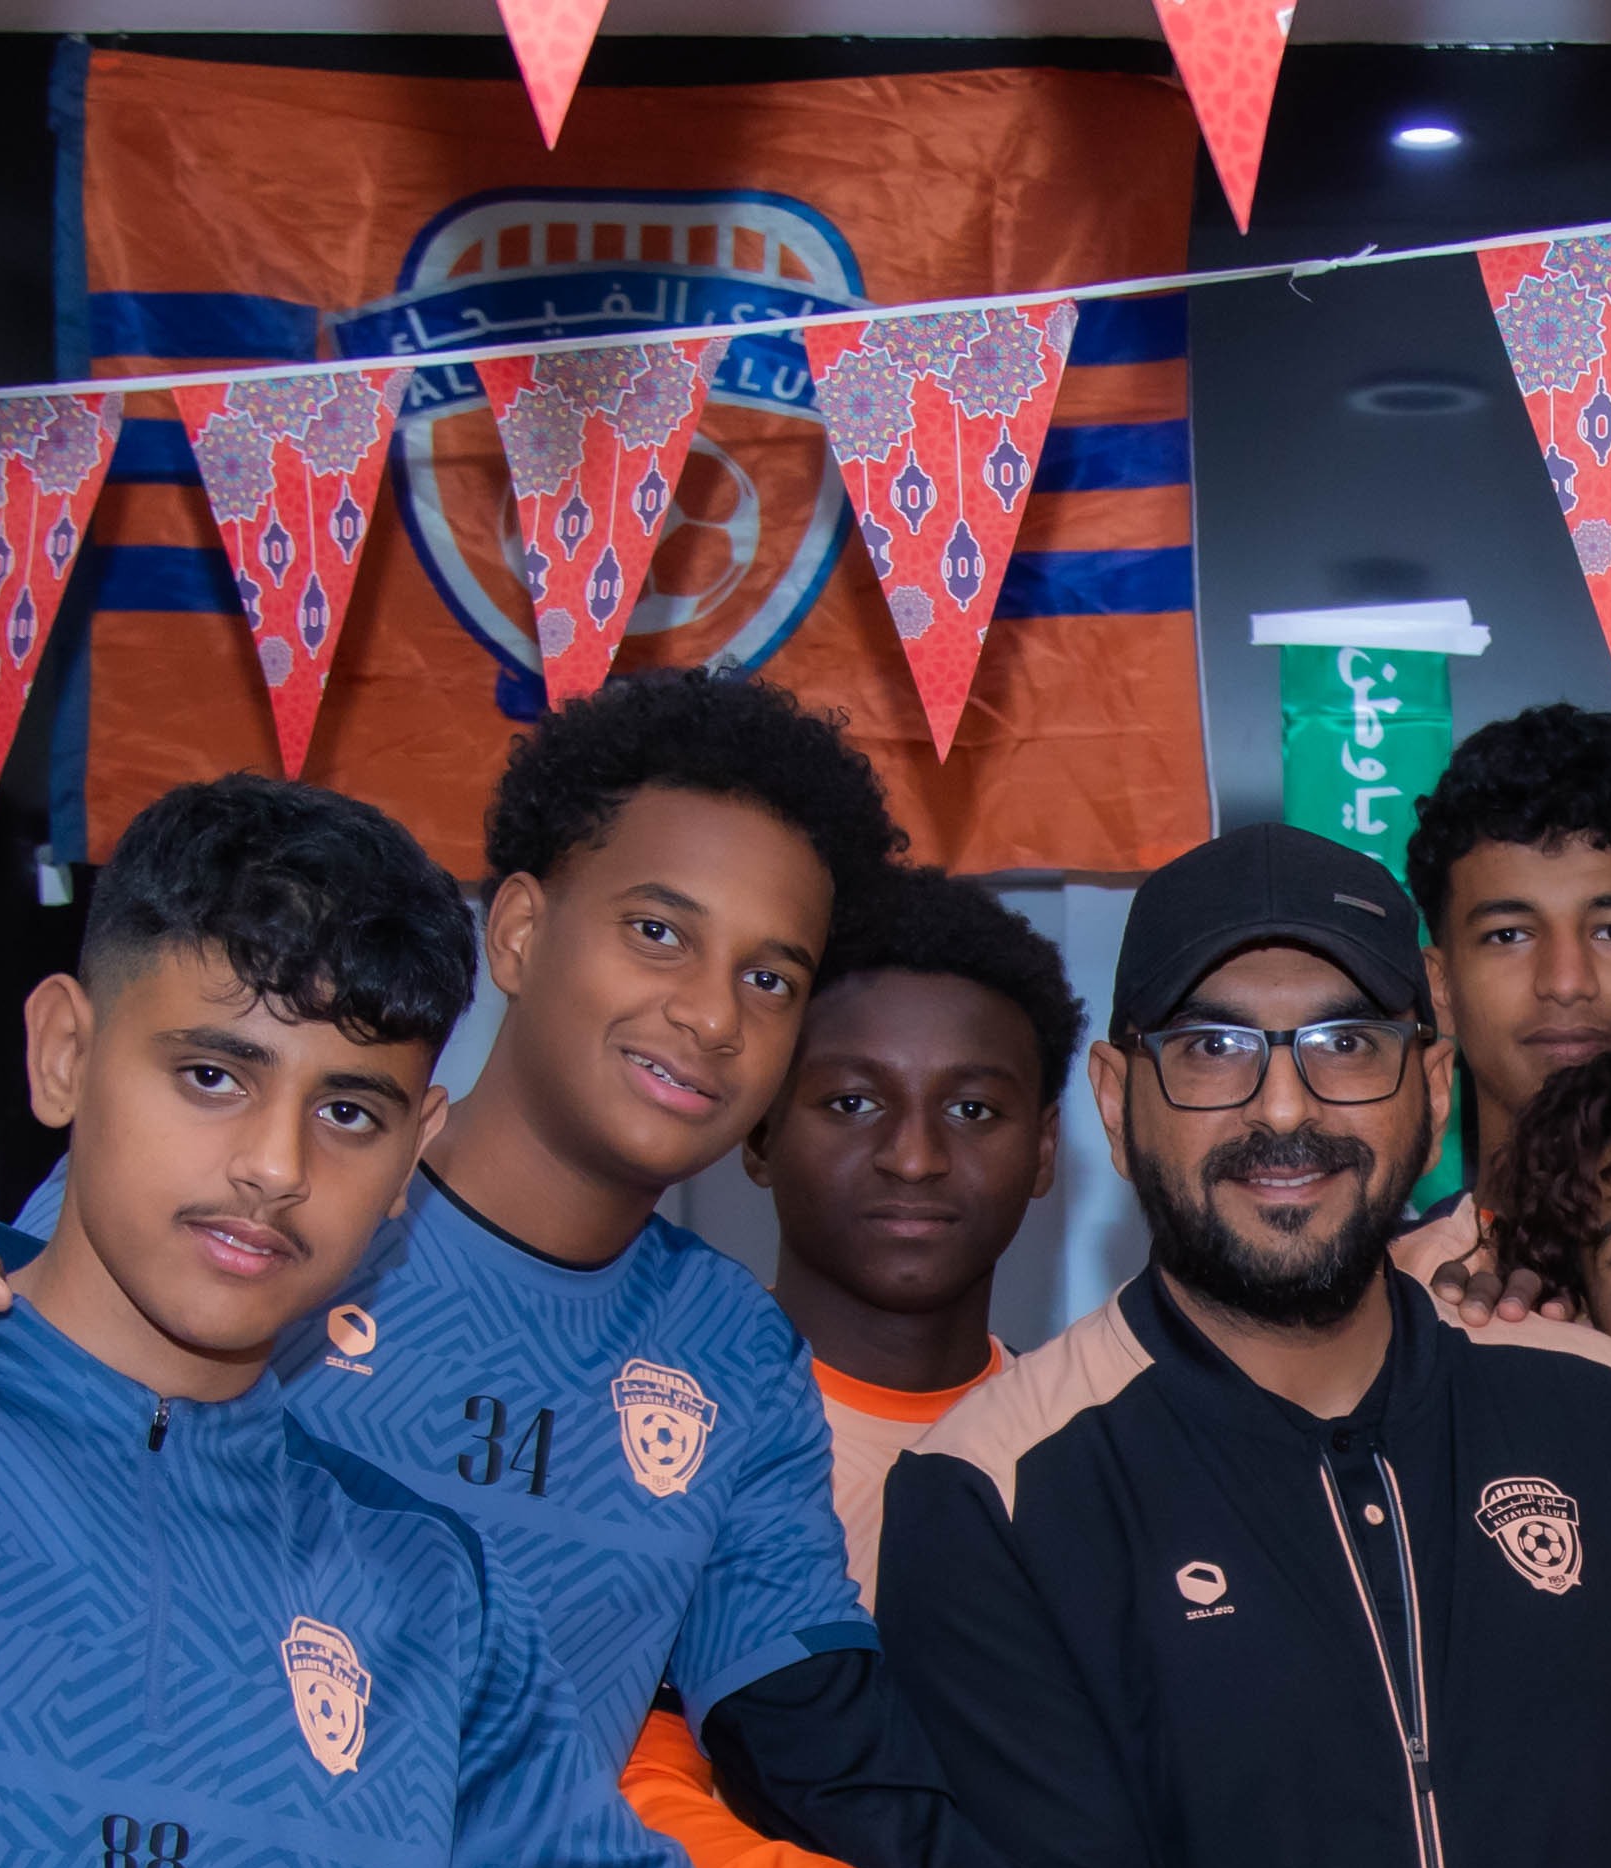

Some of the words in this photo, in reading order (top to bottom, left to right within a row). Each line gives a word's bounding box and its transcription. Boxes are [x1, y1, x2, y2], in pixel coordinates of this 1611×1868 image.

[392, 281, 688, 354] الفيحاء
[457, 1395, 555, 1498] 34
[1487, 1494, 1535, 1518] الفيحاء
[1538, 1497, 1567, 1508] نادي
[1493, 1507, 1537, 1527] ALFAYHA
[1540, 1508, 1568, 1518] CLUB
